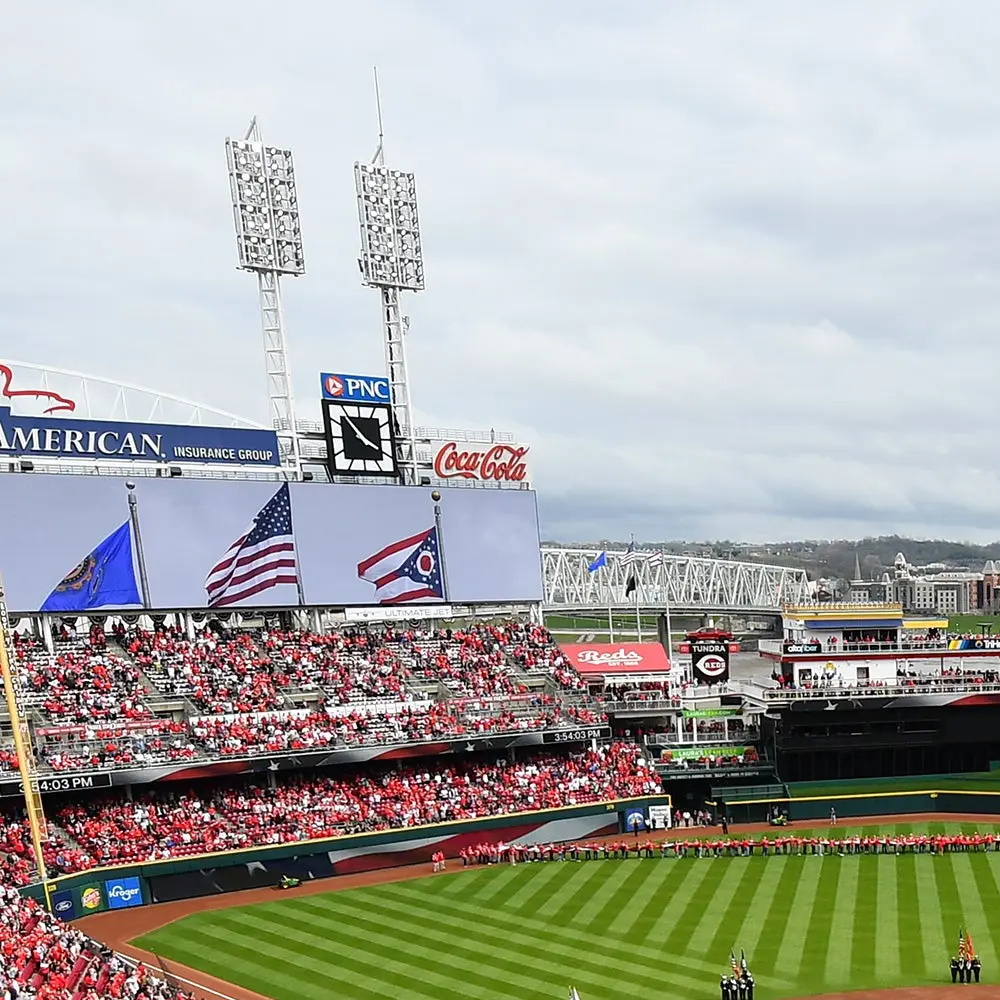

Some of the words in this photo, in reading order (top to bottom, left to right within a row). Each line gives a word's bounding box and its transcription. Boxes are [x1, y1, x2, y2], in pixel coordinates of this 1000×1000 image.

[345, 378, 388, 398] PNC
[174, 446, 235, 460] INSURANCE
[239, 449, 273, 461] GROUP
[692, 645, 726, 653] TUNDRA
[577, 649, 643, 665] Reds
[704, 661, 726, 669] REDS
[554, 731, 587, 742] 3:54:03
[587, 730, 601, 738] PM
[72, 776, 93, 788] PM
[108, 885, 140, 901] Kroger
